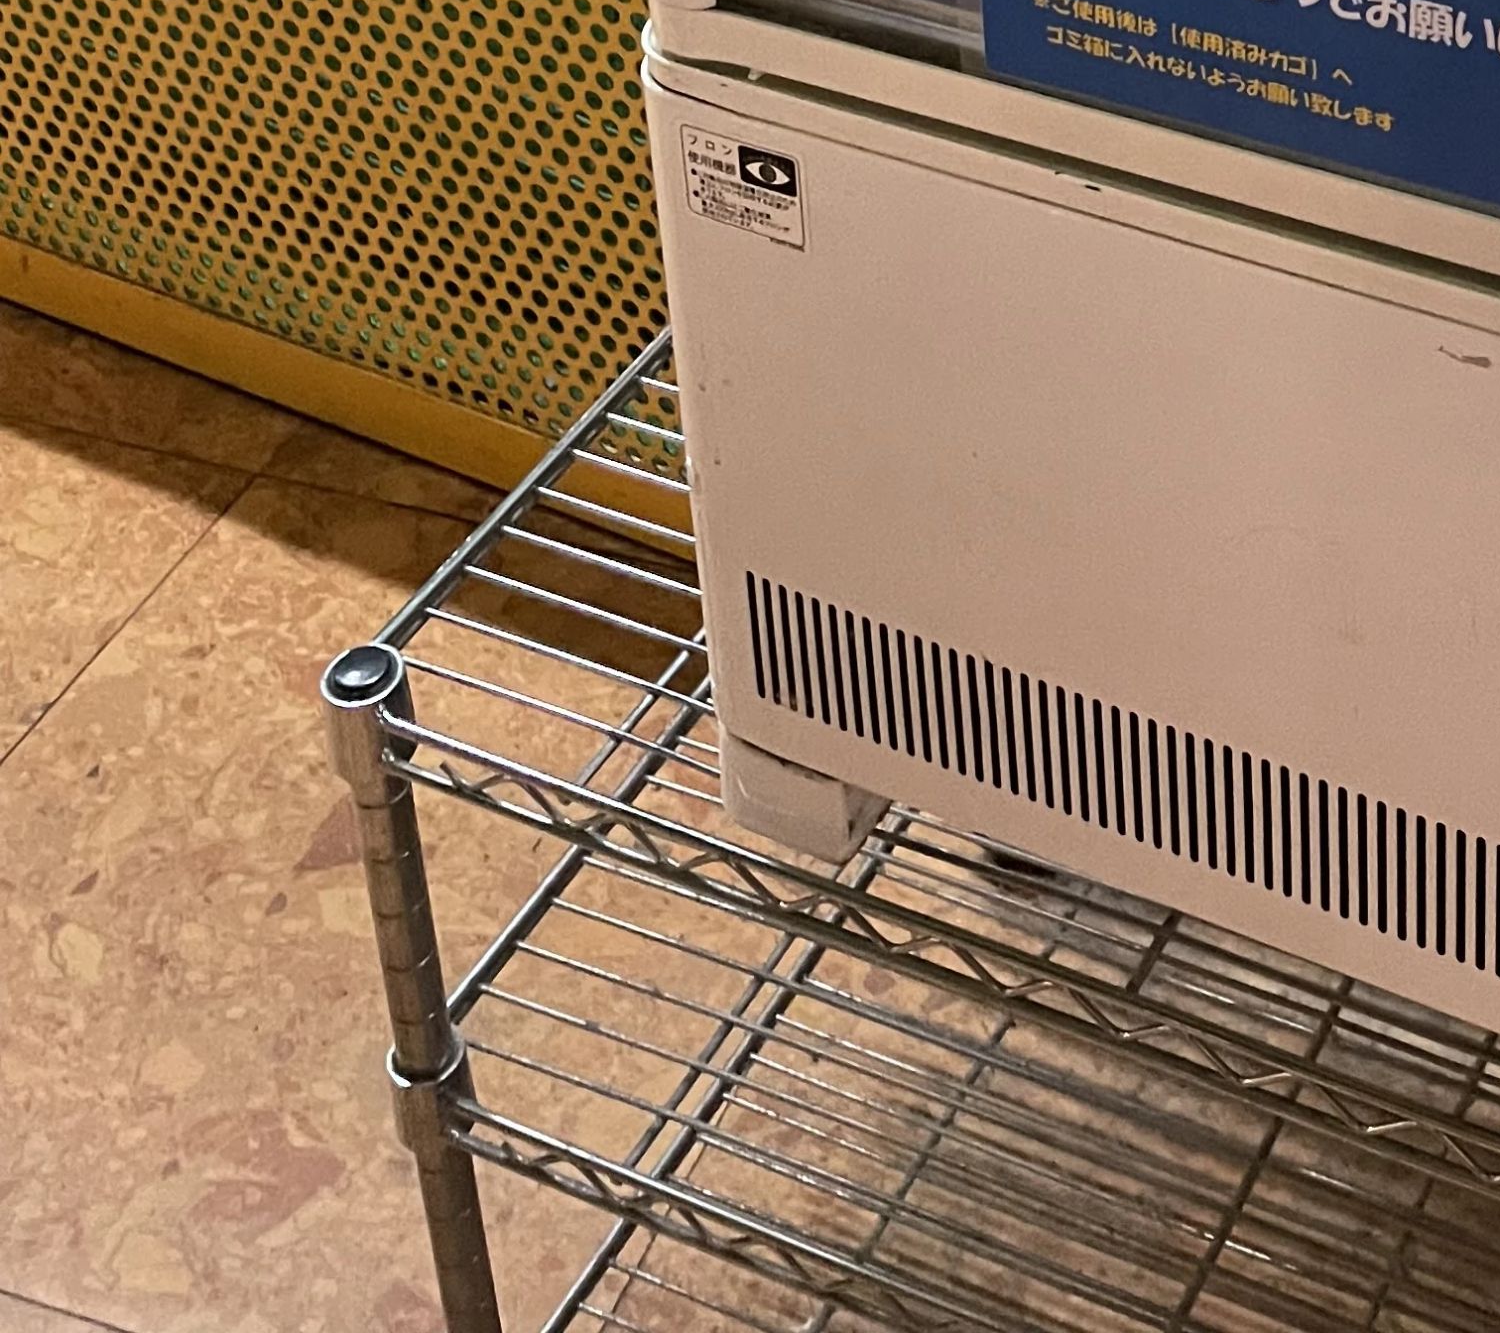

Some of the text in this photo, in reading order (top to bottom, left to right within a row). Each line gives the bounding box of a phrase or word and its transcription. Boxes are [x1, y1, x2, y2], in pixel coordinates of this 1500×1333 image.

[1046, 26, 1394, 132] ゴミ箱に入れないようお願い致します
